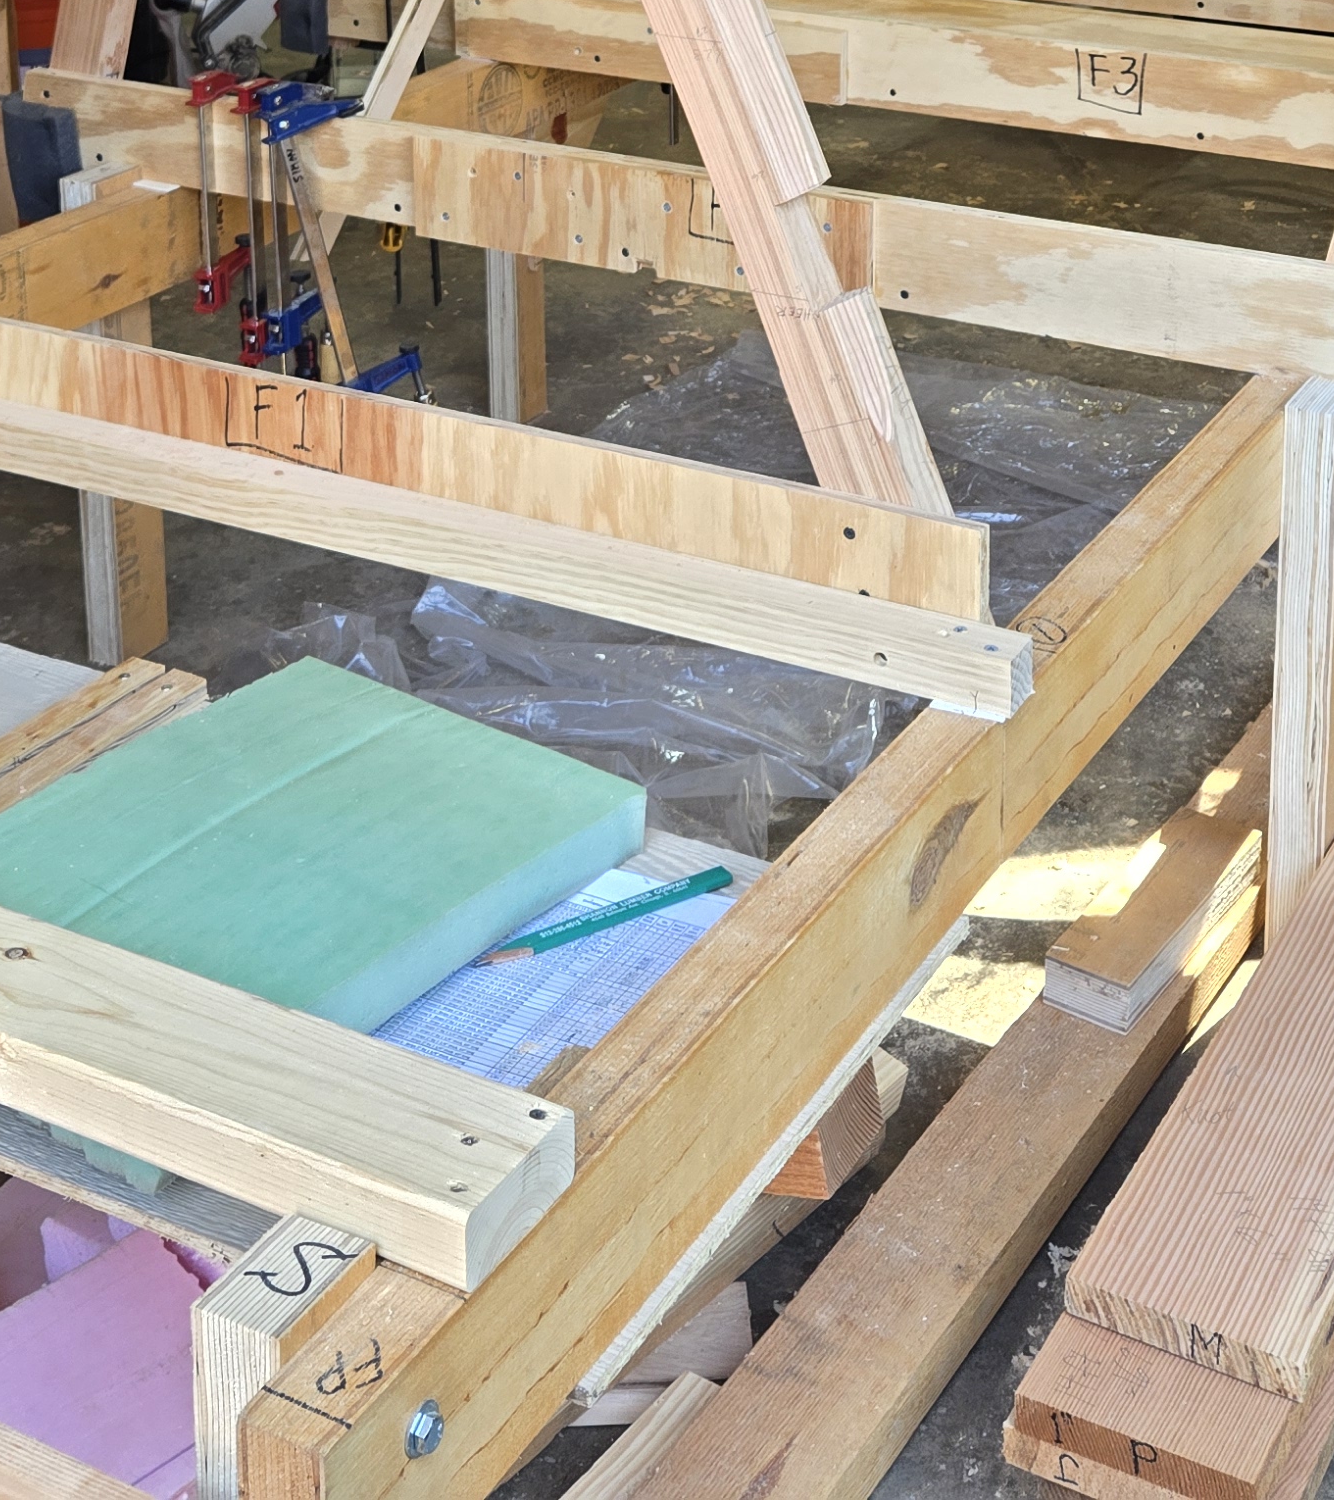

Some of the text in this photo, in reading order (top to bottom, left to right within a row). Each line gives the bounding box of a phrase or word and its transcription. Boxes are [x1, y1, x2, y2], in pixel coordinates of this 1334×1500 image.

[1089, 53, 1140, 98] F3
[254, 384, 313, 451] F1
[619, 890, 653, 907] LUMBER
[653, 878, 692, 896] COMPANY
[1189, 1323, 1224, 1365] M
